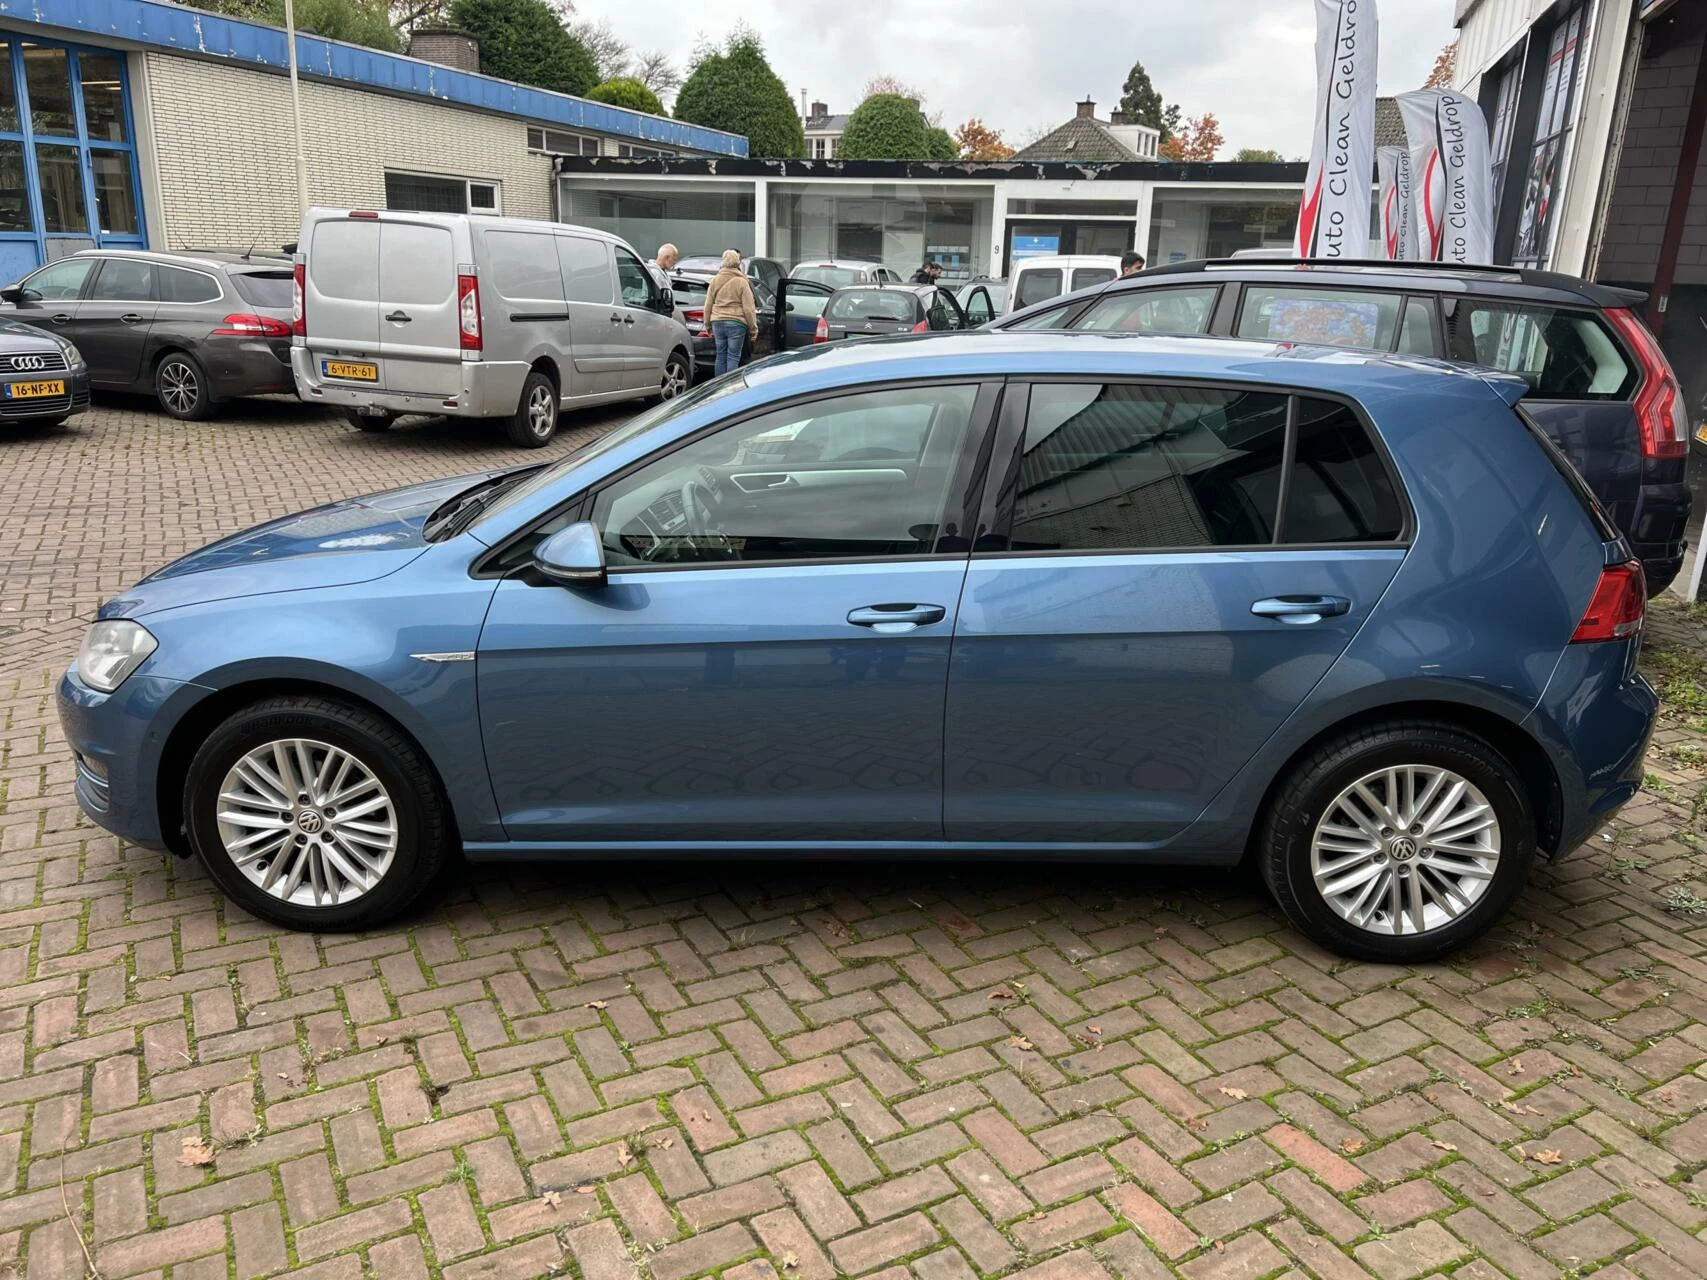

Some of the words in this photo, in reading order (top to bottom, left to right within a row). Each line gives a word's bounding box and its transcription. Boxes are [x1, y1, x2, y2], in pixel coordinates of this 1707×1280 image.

[1336, 0, 1357, 99] Geldro
[1329, 112, 1350, 196] Clean
[1442, 96, 1466, 168] Geldrop
[1400, 152, 1410, 199] Geldrop
[1448, 176, 1466, 229] Clean
[994, 245, 1000, 255] 9
[1325, 211, 1344, 258] uto
[15, 383, 60, 396] 16-NF-XX
[331, 364, 372, 377] 6-VTR-61
